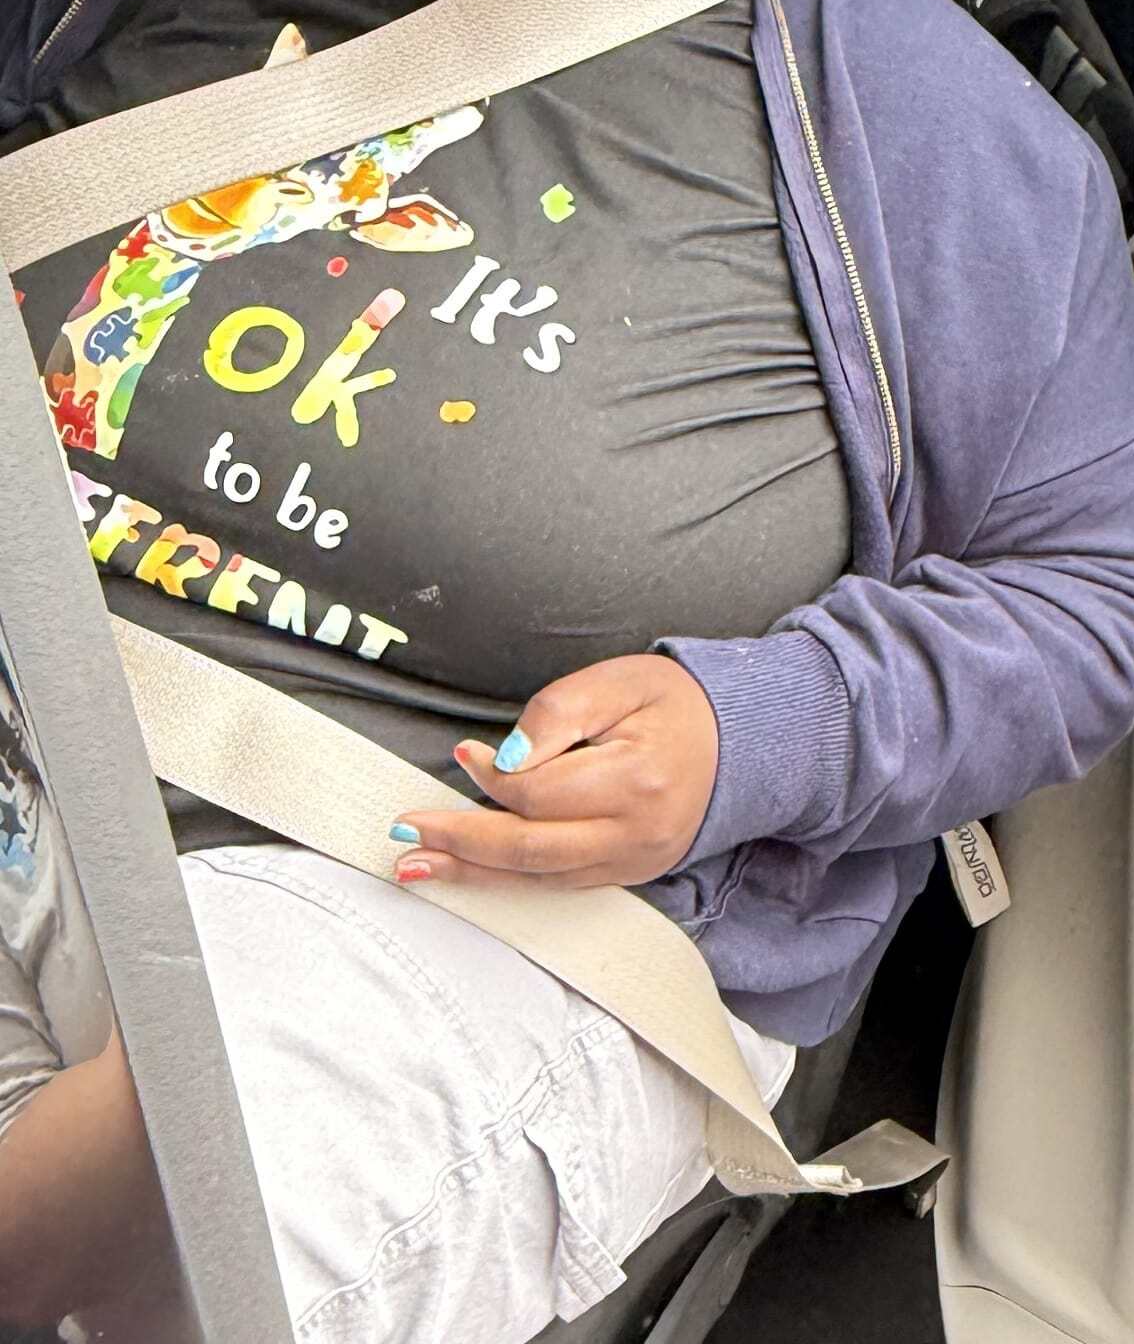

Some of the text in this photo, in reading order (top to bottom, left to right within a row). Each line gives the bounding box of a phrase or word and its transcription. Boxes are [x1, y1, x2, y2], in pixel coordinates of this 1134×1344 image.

[429, 255, 577, 373] It's
[203, 431, 350, 550] to be
